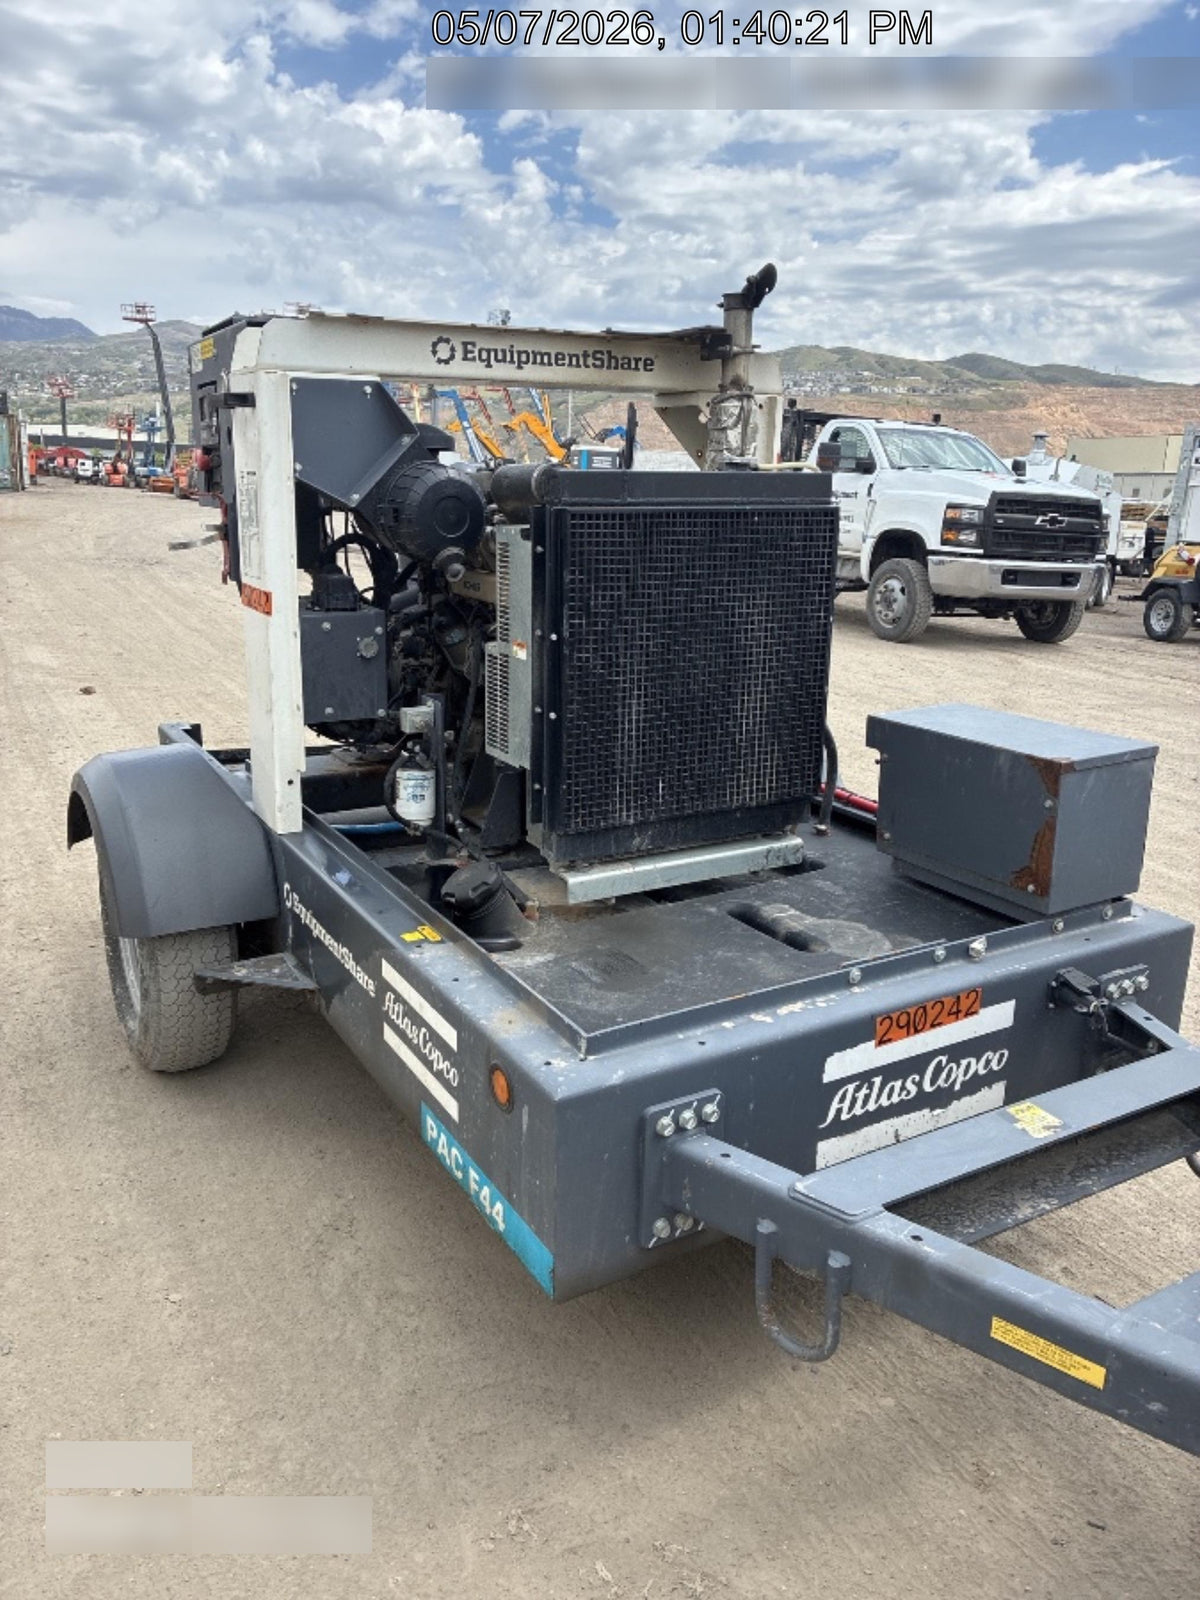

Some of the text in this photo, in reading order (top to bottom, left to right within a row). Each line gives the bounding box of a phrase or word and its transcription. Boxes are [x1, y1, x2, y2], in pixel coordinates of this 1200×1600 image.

[461, 341, 655, 373] EquipmentShare
[292, 891, 377, 998] EquipmentShare
[382, 991, 459, 1087] Atlas Copco
[877, 988, 980, 1046] 290242
[817, 1048, 1010, 1129] Atlas Copco
[425, 1114, 506, 1233] PAC F44
